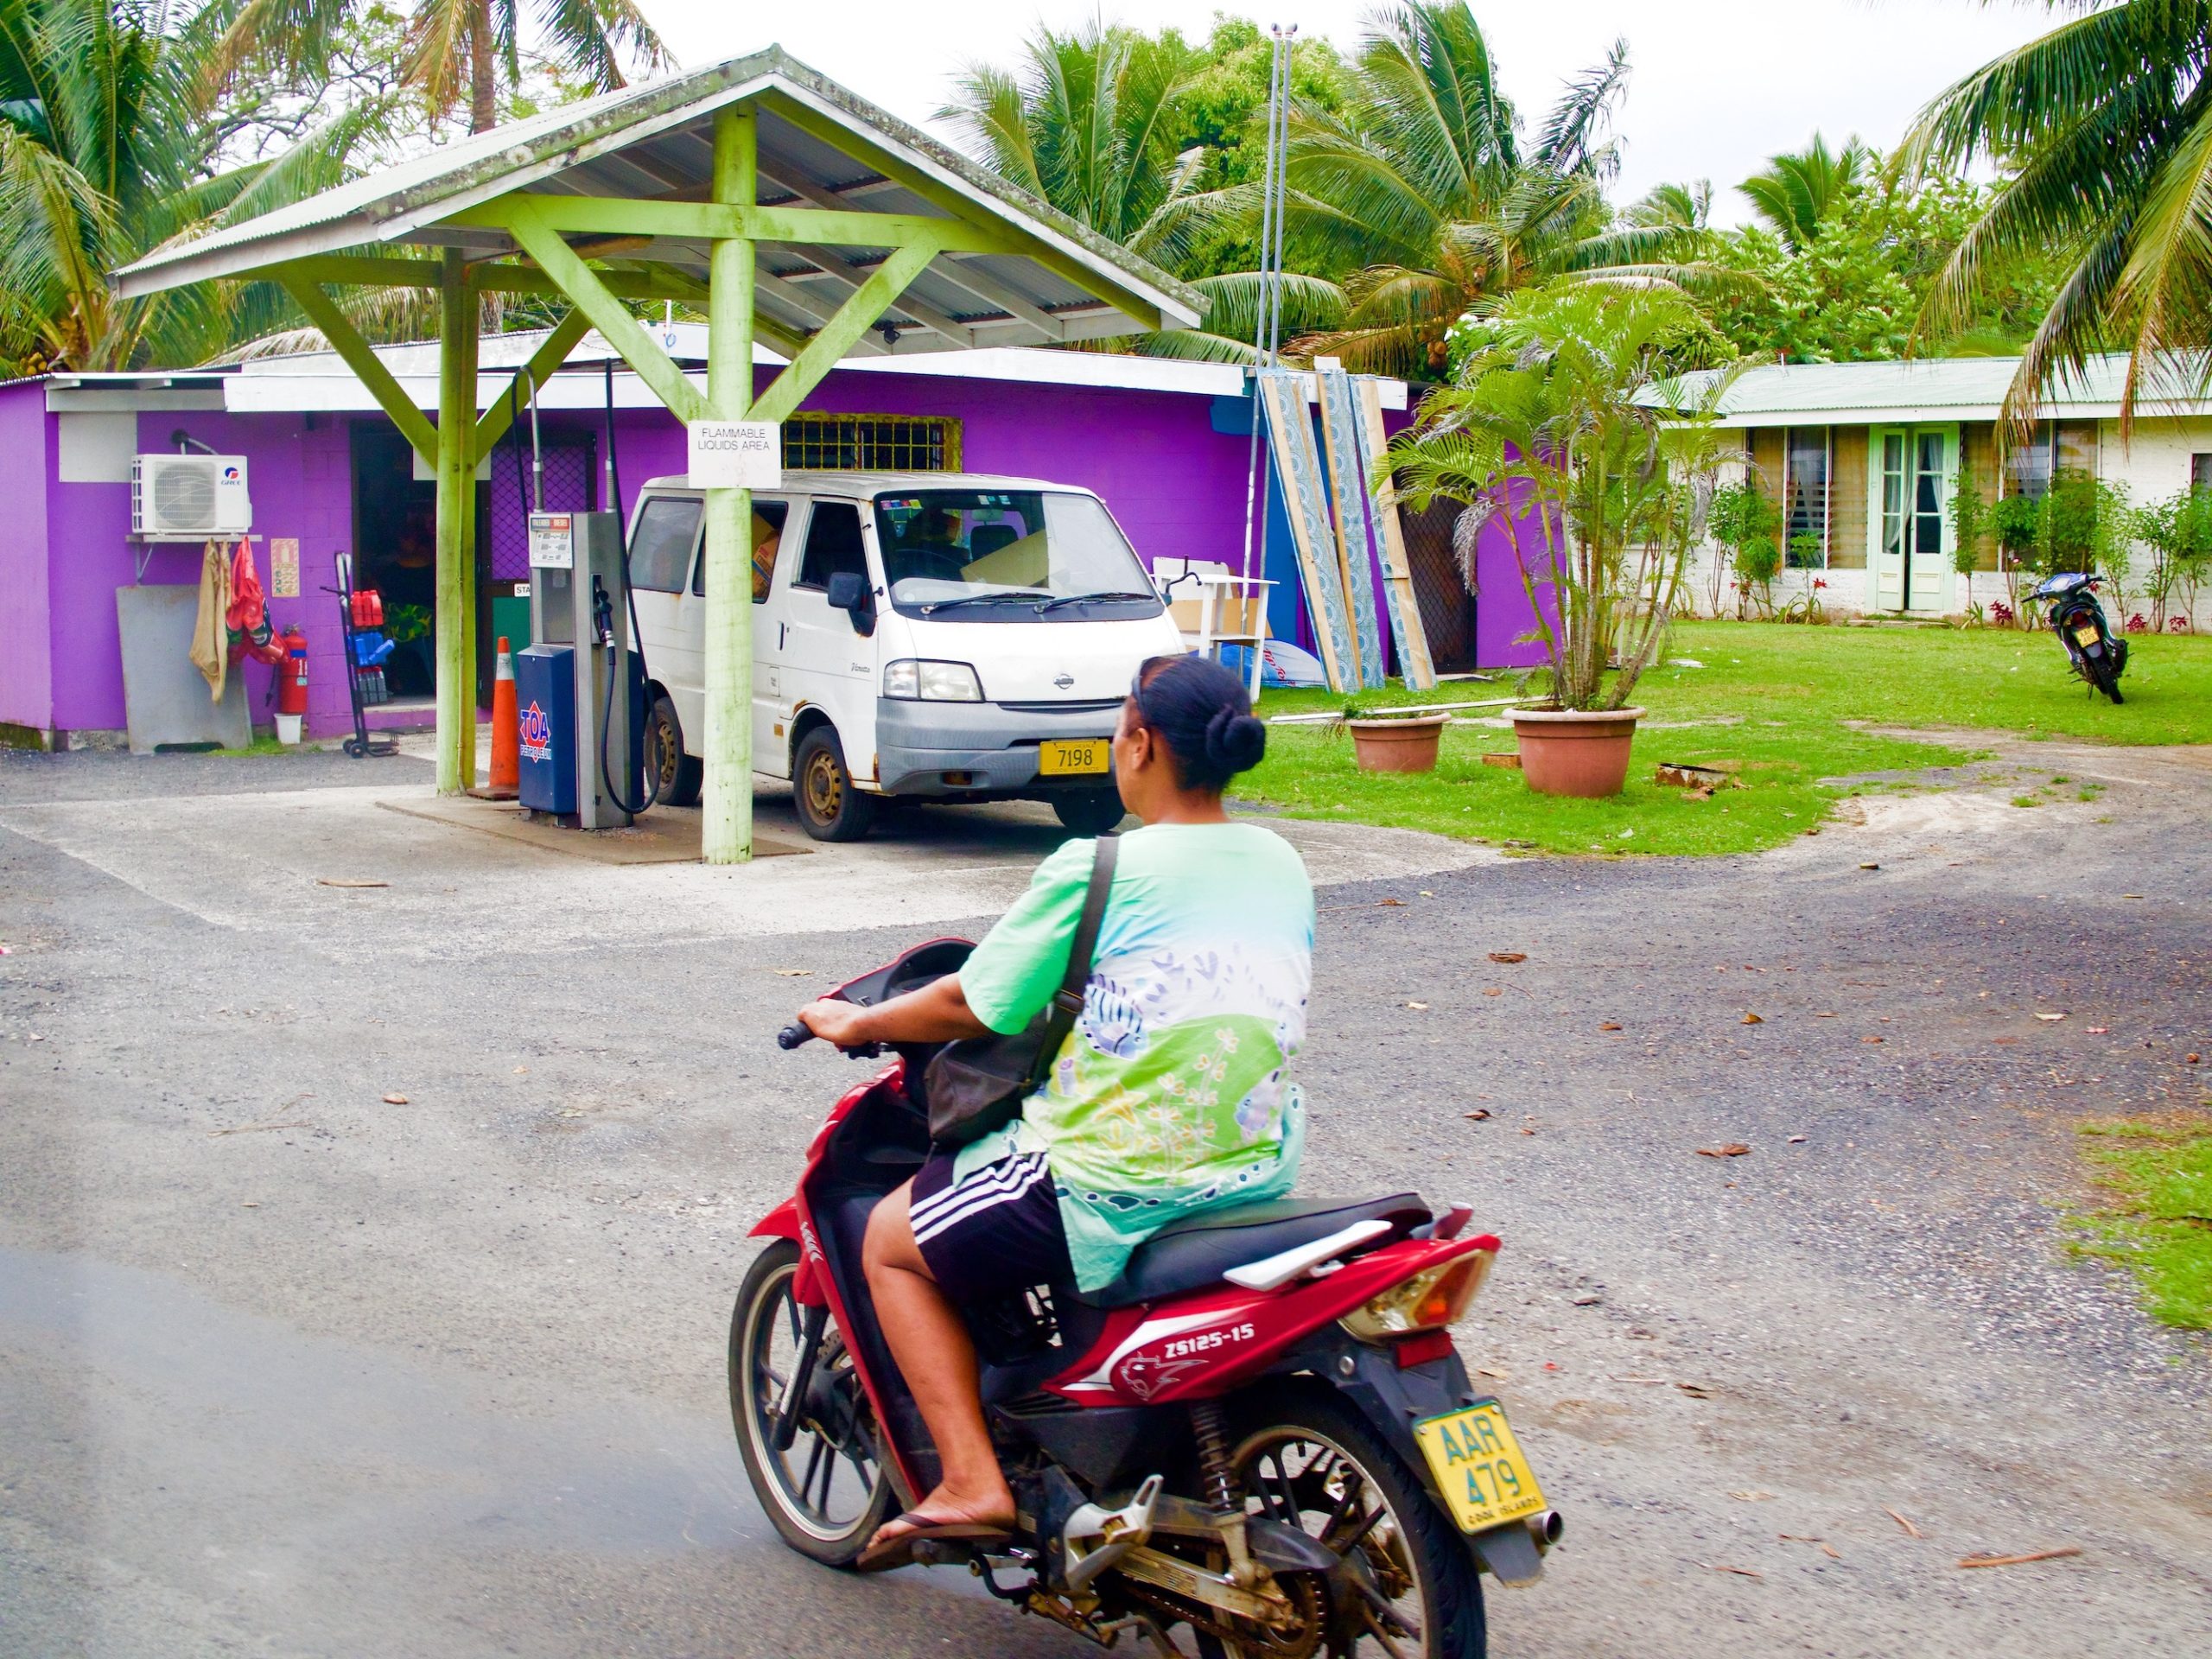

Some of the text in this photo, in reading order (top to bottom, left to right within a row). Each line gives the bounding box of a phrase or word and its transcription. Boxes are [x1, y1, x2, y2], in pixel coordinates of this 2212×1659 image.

[697, 440, 770, 450] LIQUIDS AREA
[702, 428, 766, 439] FLAMMABLE
[520, 709, 550, 743] TOA
[520, 744, 552, 760] PETROLEUM
[1058, 748, 1093, 767] 7198
[1164, 1323, 1255, 1359] ZS125-15
[1439, 1414, 1505, 1466] AAR
[1465, 1458, 1522, 1507] 479
[1468, 1496, 1539, 1525] COOK ISLANDS
